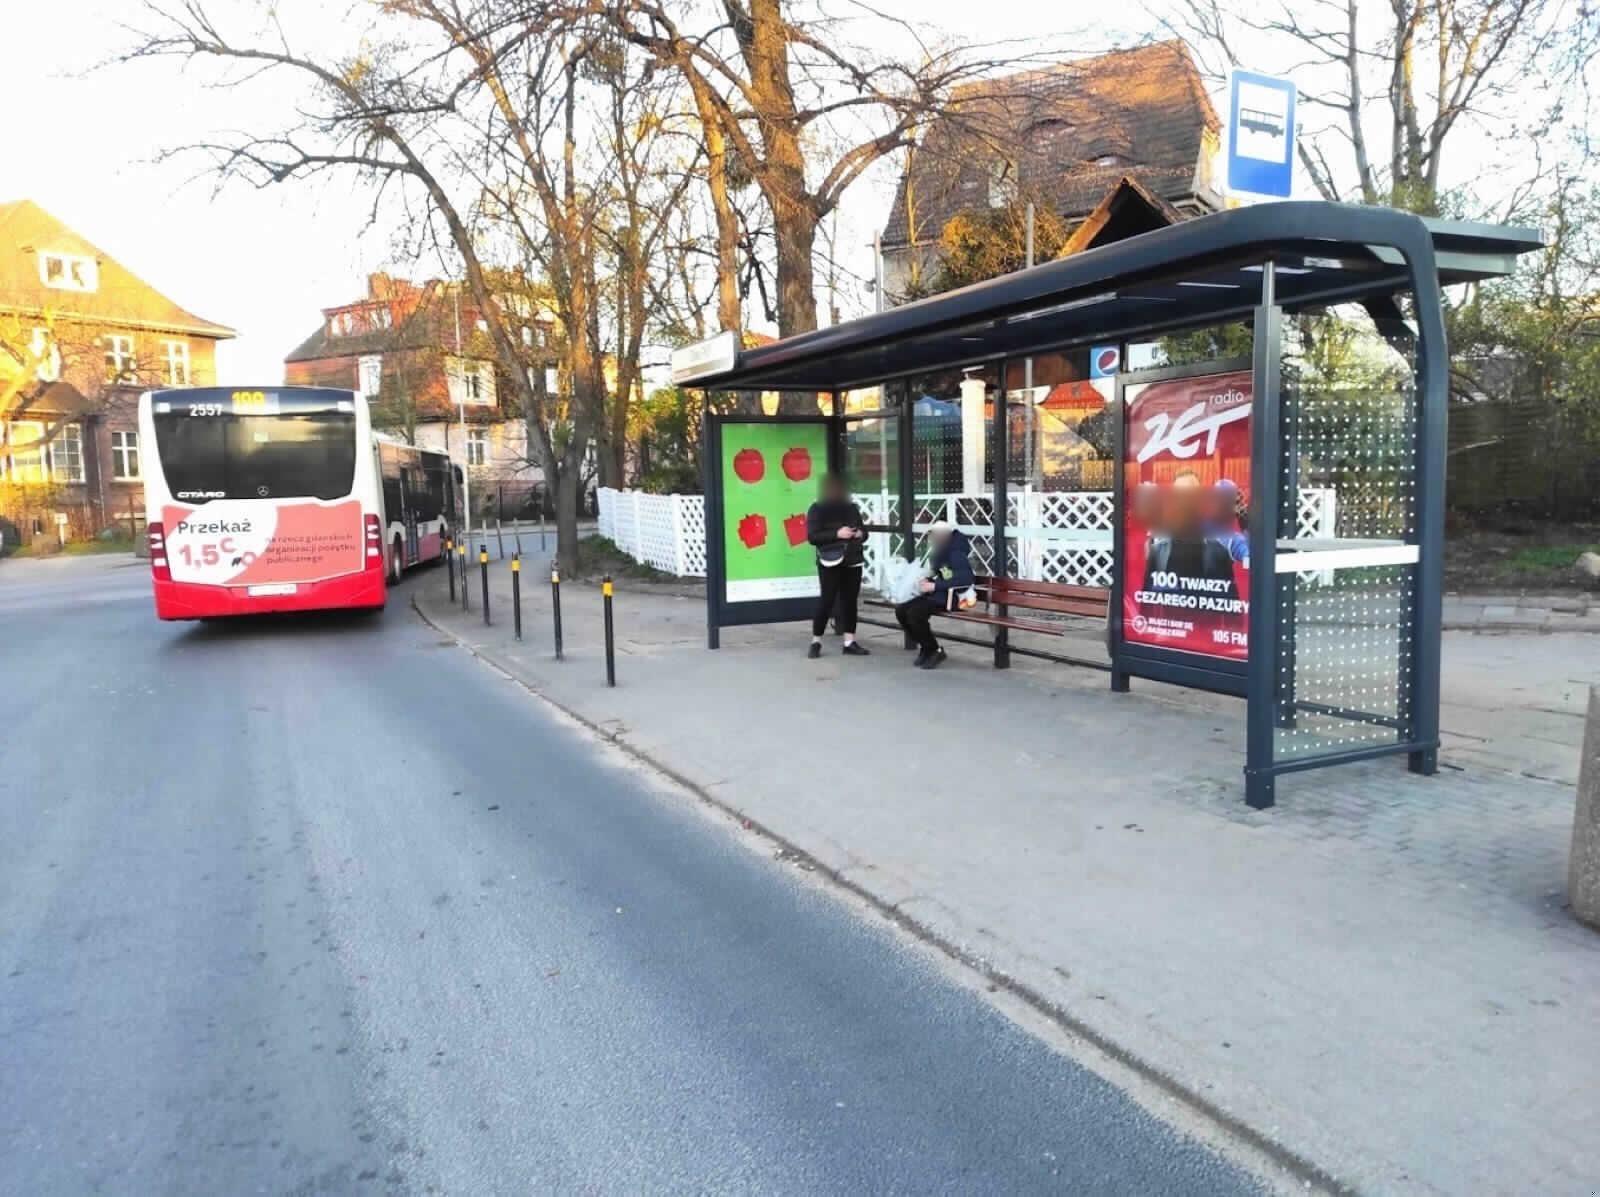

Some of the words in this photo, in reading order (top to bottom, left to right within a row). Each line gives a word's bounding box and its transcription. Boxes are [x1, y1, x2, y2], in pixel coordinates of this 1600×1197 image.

[1209, 389, 1245, 405] radio
[189, 404, 223, 417] 2557
[1136, 402, 1253, 464] ZET
[177, 490, 225, 499] CITARO
[177, 518, 252, 534] Przekaż
[1151, 571, 1178, 589] 100
[1179, 576, 1231, 592] TWARZY
[1134, 591, 1197, 608] CEZAREGO
[1199, 596, 1249, 614] PAZURY
[1212, 629, 1229, 644] 105
[1231, 631, 1249, 647] FM
